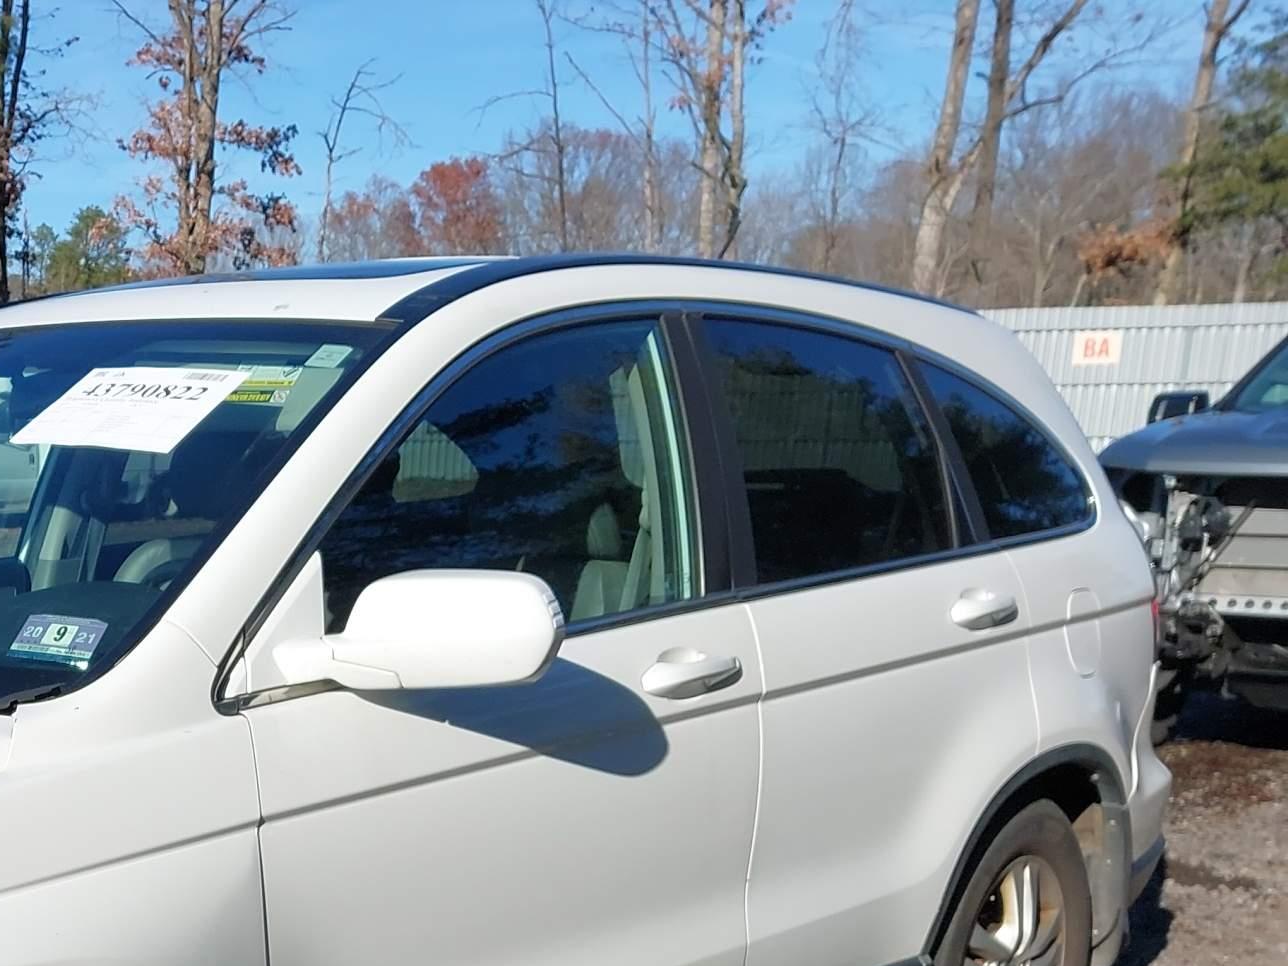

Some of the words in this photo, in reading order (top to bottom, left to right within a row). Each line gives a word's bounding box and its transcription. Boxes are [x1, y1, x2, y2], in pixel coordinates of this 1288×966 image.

[1083, 337, 1109, 359] BA
[82, 382, 209, 401] 43790822
[23, 625, 44, 638] 20
[53, 625, 68, 642] 9
[75, 632, 96, 644] 21
